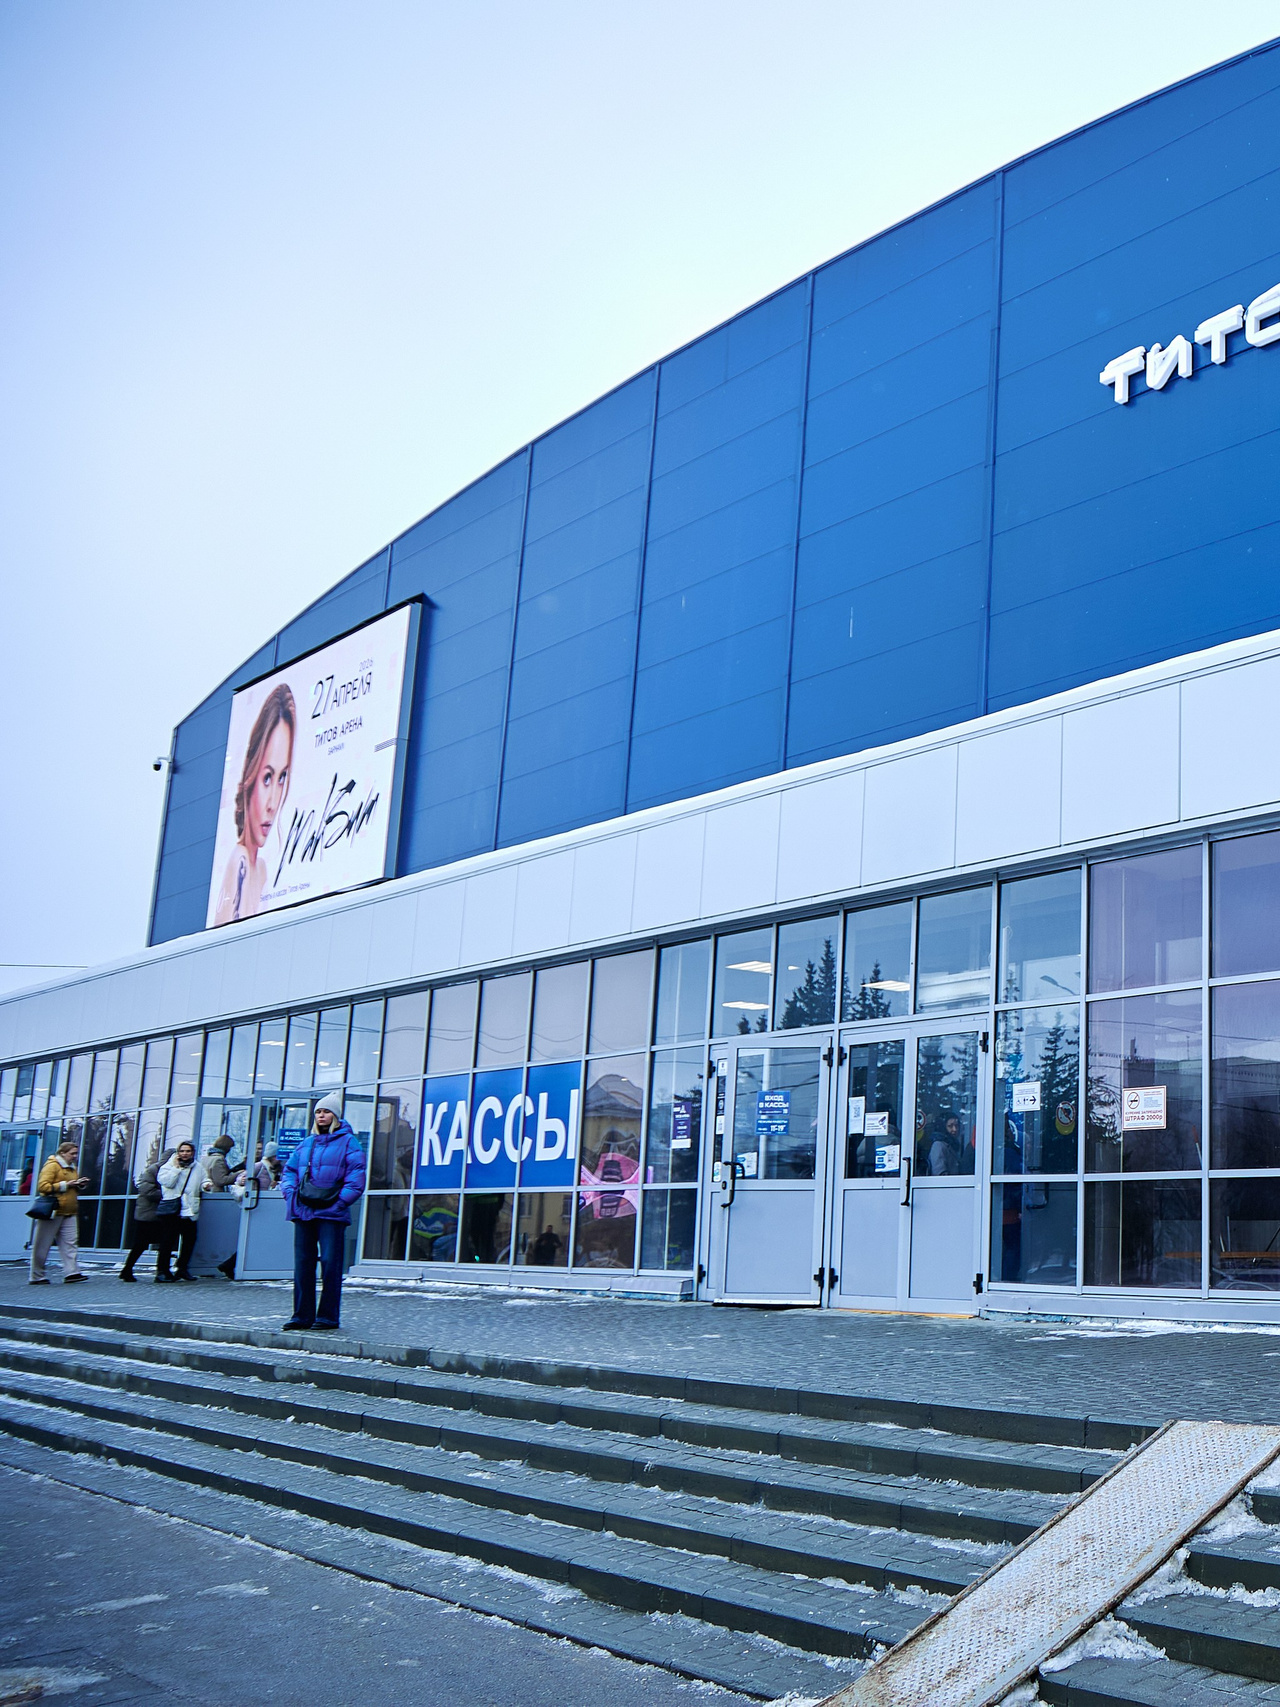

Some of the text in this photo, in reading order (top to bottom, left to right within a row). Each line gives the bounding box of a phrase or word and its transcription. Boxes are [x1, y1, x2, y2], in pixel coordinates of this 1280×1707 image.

[311, 671, 372, 720] 27 АПРЕЛЯ
[314, 714, 363, 748] ТИТОВ АРЕНА
[421, 1089, 579, 1167] КАССЫ
